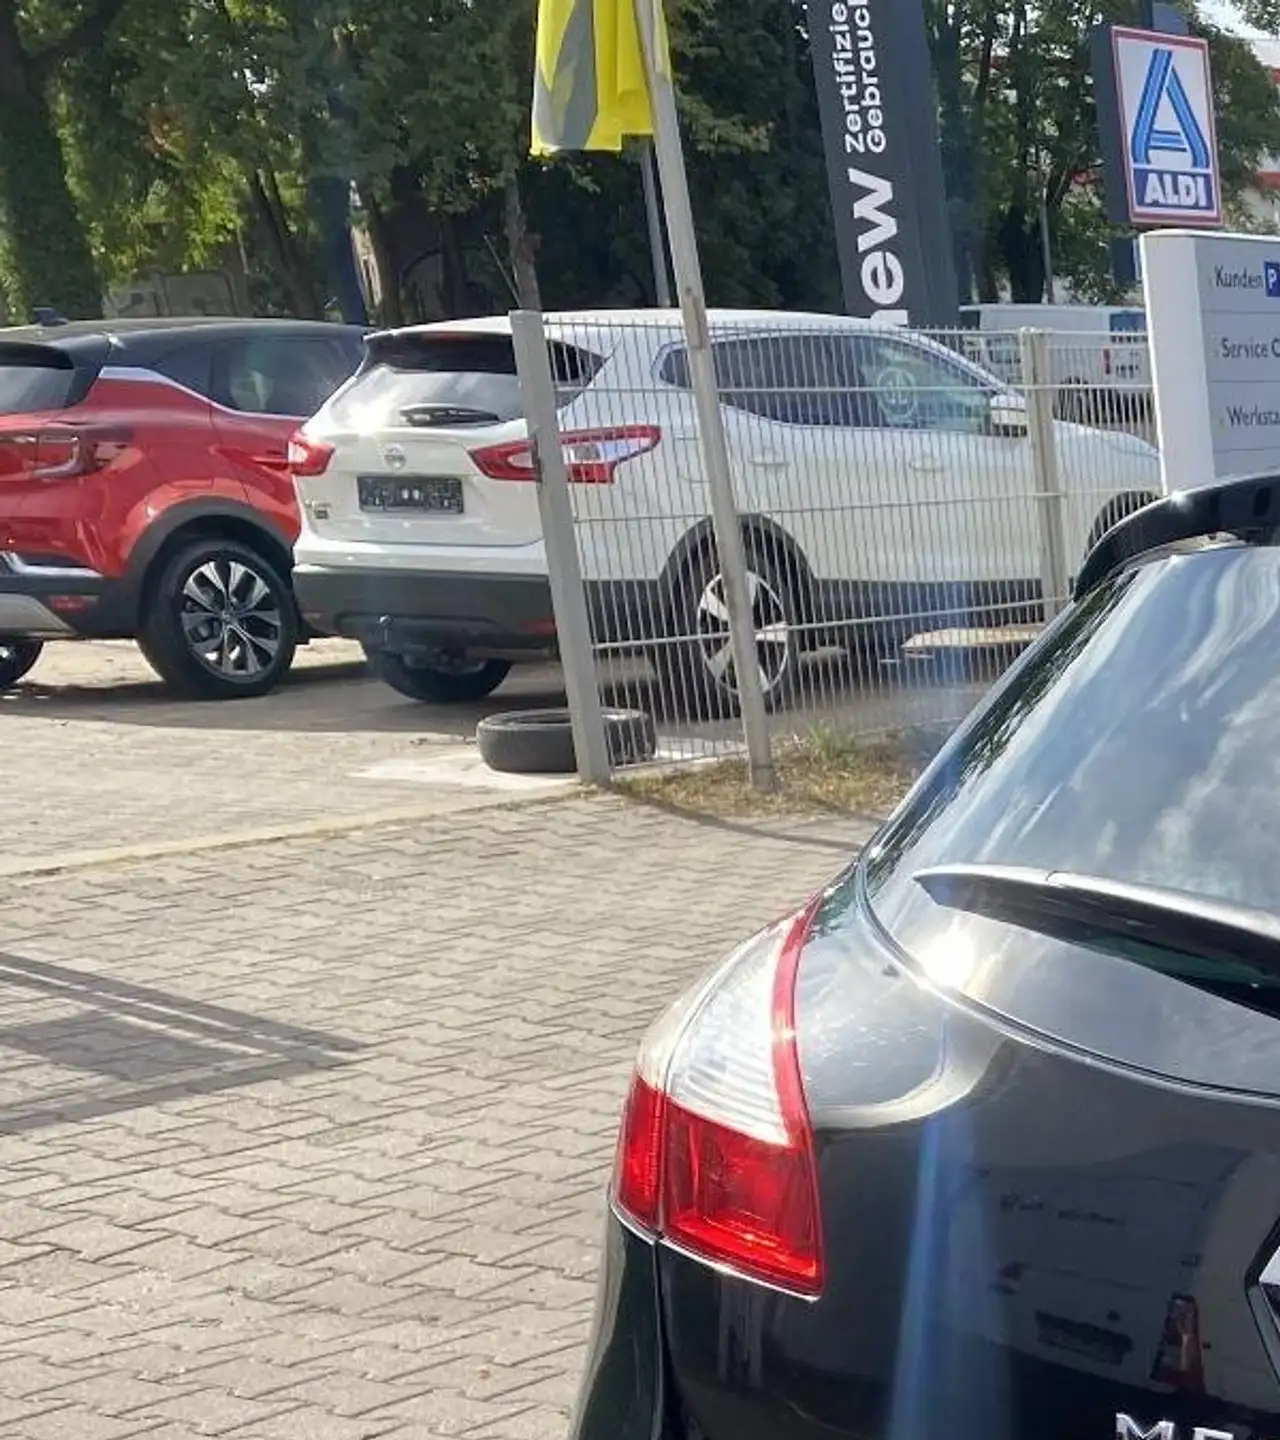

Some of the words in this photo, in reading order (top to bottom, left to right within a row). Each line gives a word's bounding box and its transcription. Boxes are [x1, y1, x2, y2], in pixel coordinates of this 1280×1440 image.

[1143, 172, 1207, 206] ALDI
[1215, 265, 1263, 289] Kunden
[1221, 338, 1268, 358] Service
